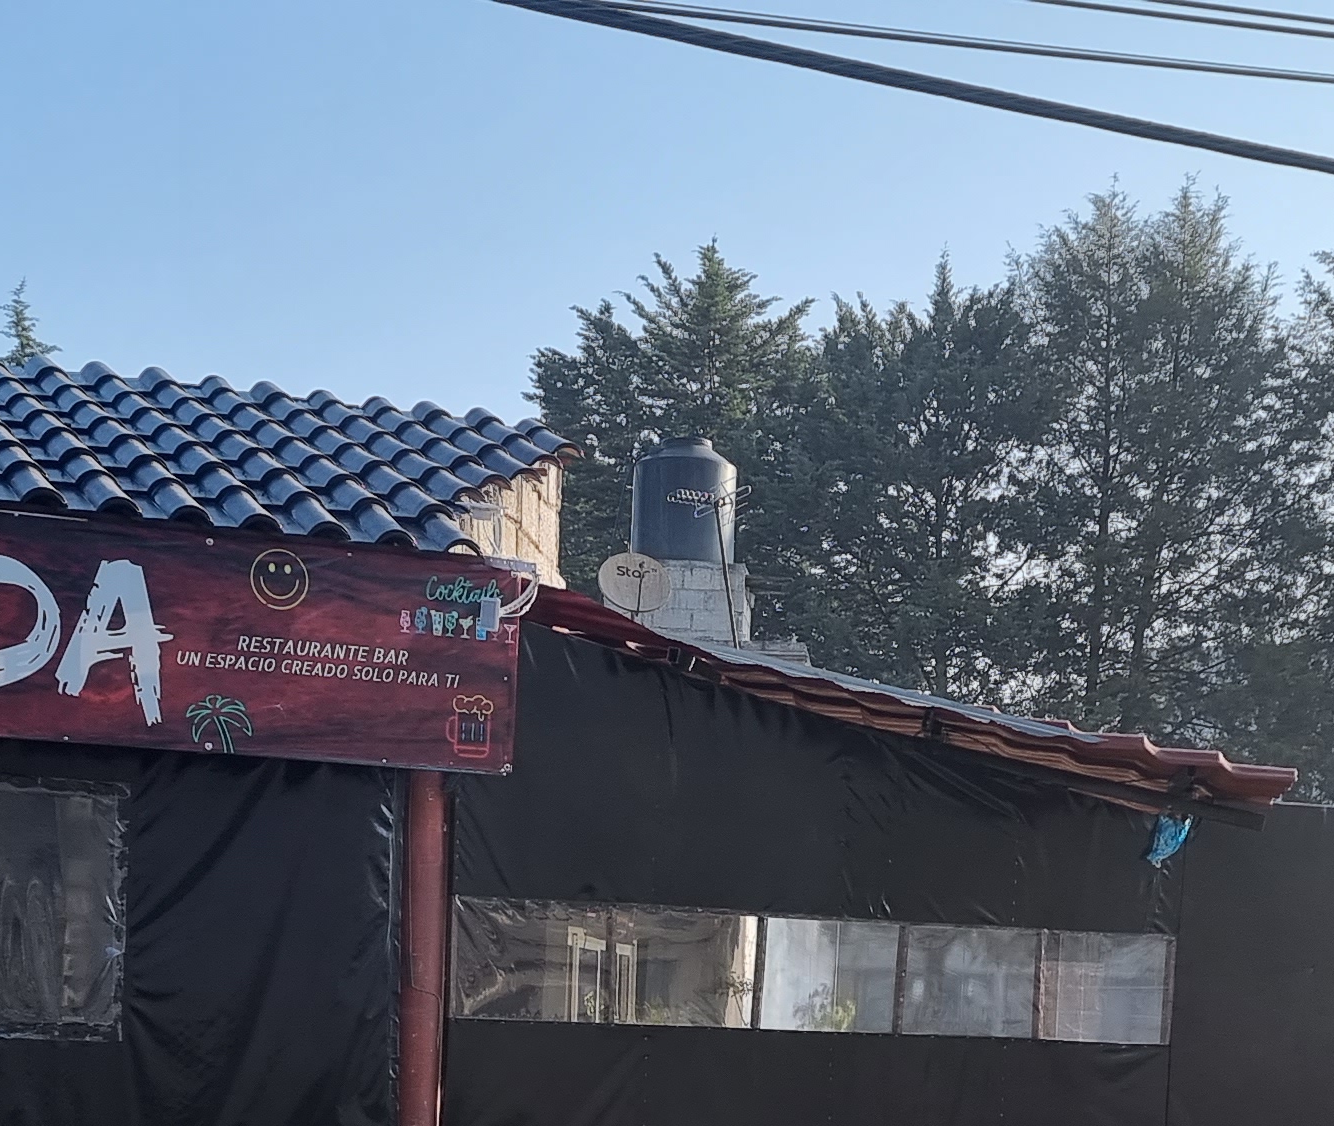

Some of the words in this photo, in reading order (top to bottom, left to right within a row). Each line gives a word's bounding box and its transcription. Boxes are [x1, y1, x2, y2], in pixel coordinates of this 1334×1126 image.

[237, 635, 370, 662] RESTAURANTE
[372, 647, 409, 666] BAR
[176, 650, 202, 667] UN
[205, 653, 276, 672] ESPACIO
[281, 659, 348, 679] CREADO
[352, 665, 394, 683] SOLO
[397, 669, 439, 688] PARA
[445, 673, 460, 689] TI
